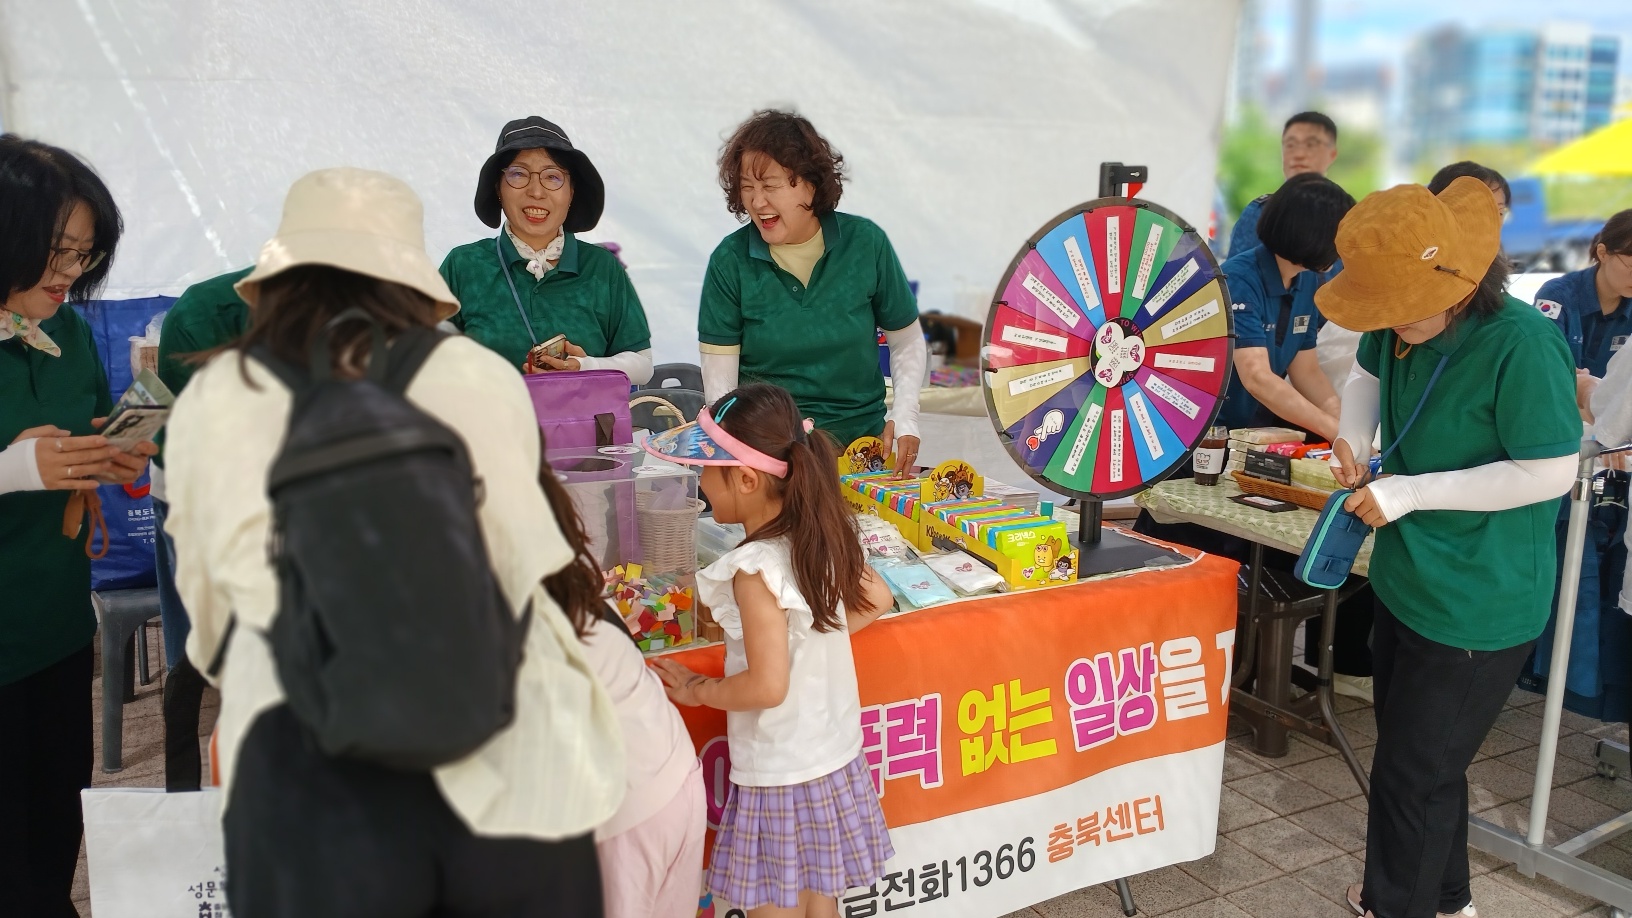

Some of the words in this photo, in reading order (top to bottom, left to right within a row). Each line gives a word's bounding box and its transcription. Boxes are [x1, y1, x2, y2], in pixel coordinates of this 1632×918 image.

[957, 678, 1058, 777] 없는
[1064, 635, 1210, 753] 일상을
[1047, 794, 1165, 864] 충북센터
